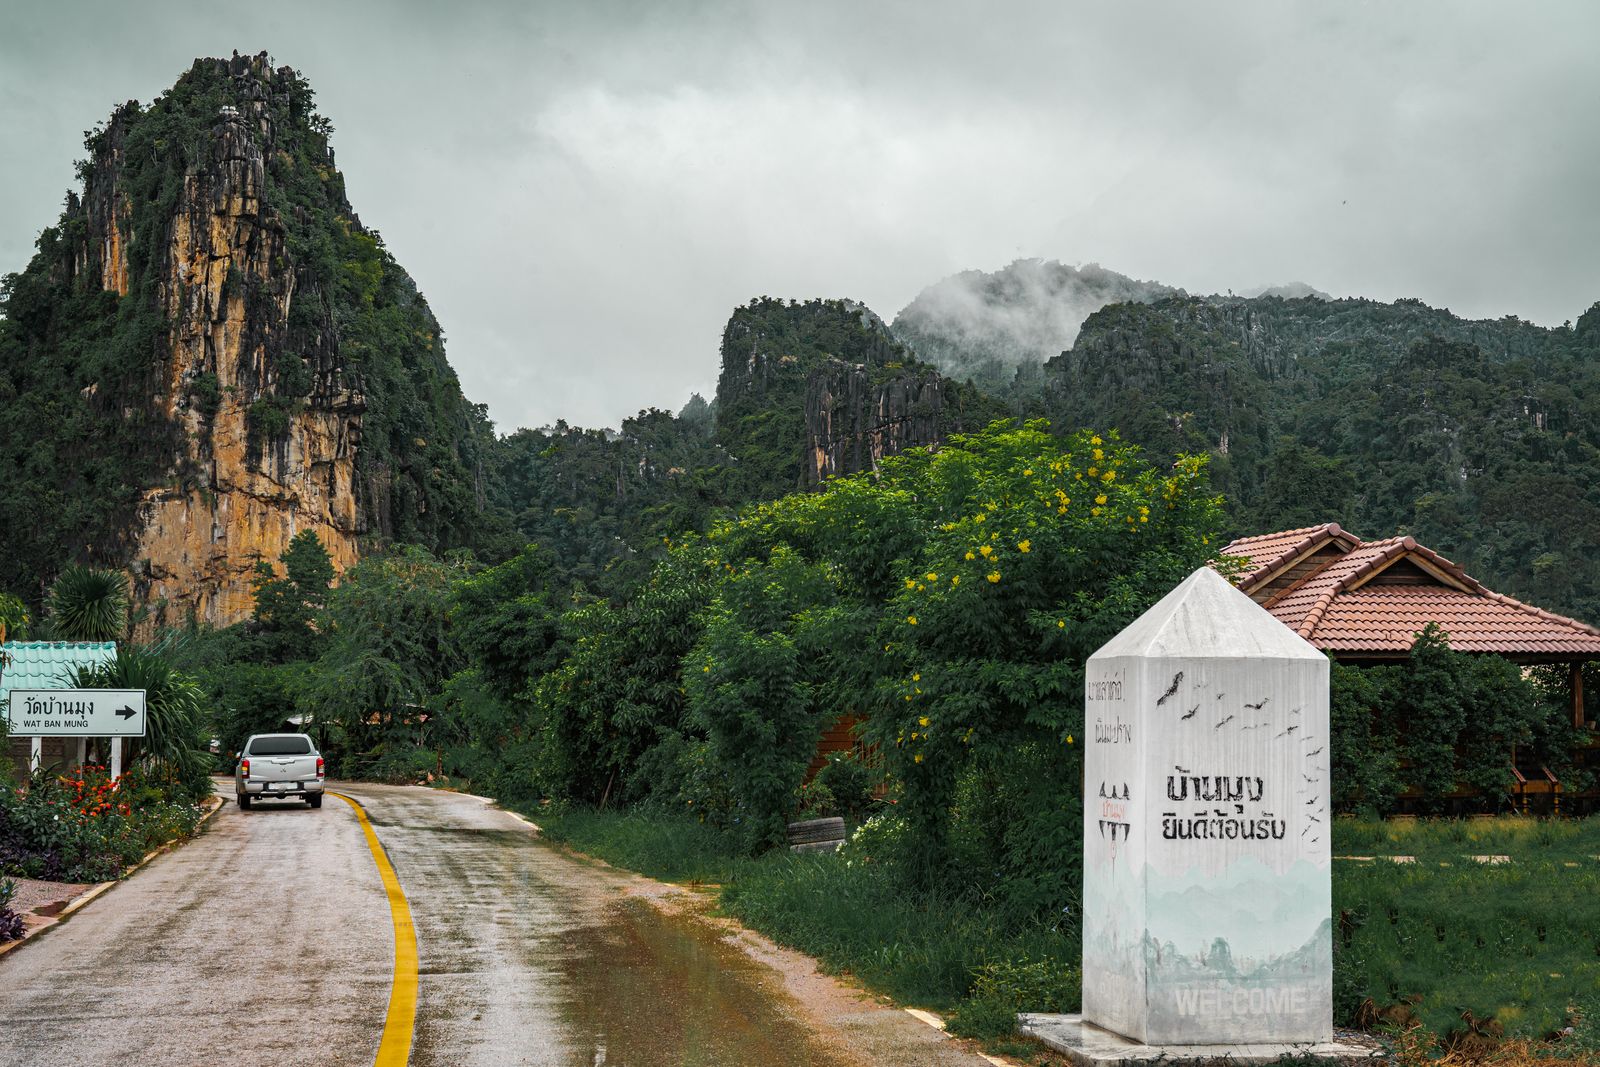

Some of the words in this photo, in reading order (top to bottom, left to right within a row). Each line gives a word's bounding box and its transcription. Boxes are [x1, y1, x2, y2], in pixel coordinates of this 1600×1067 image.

[24, 696, 94, 720] วัดบ้านมุง
[23, 720, 41, 728] WAT
[44, 720, 61, 728] BAN
[64, 720, 89, 728] MUNG
[1162, 810, 1286, 840] ยินดีต้อนรับ
[1175, 986, 1306, 1016] WELCOME
